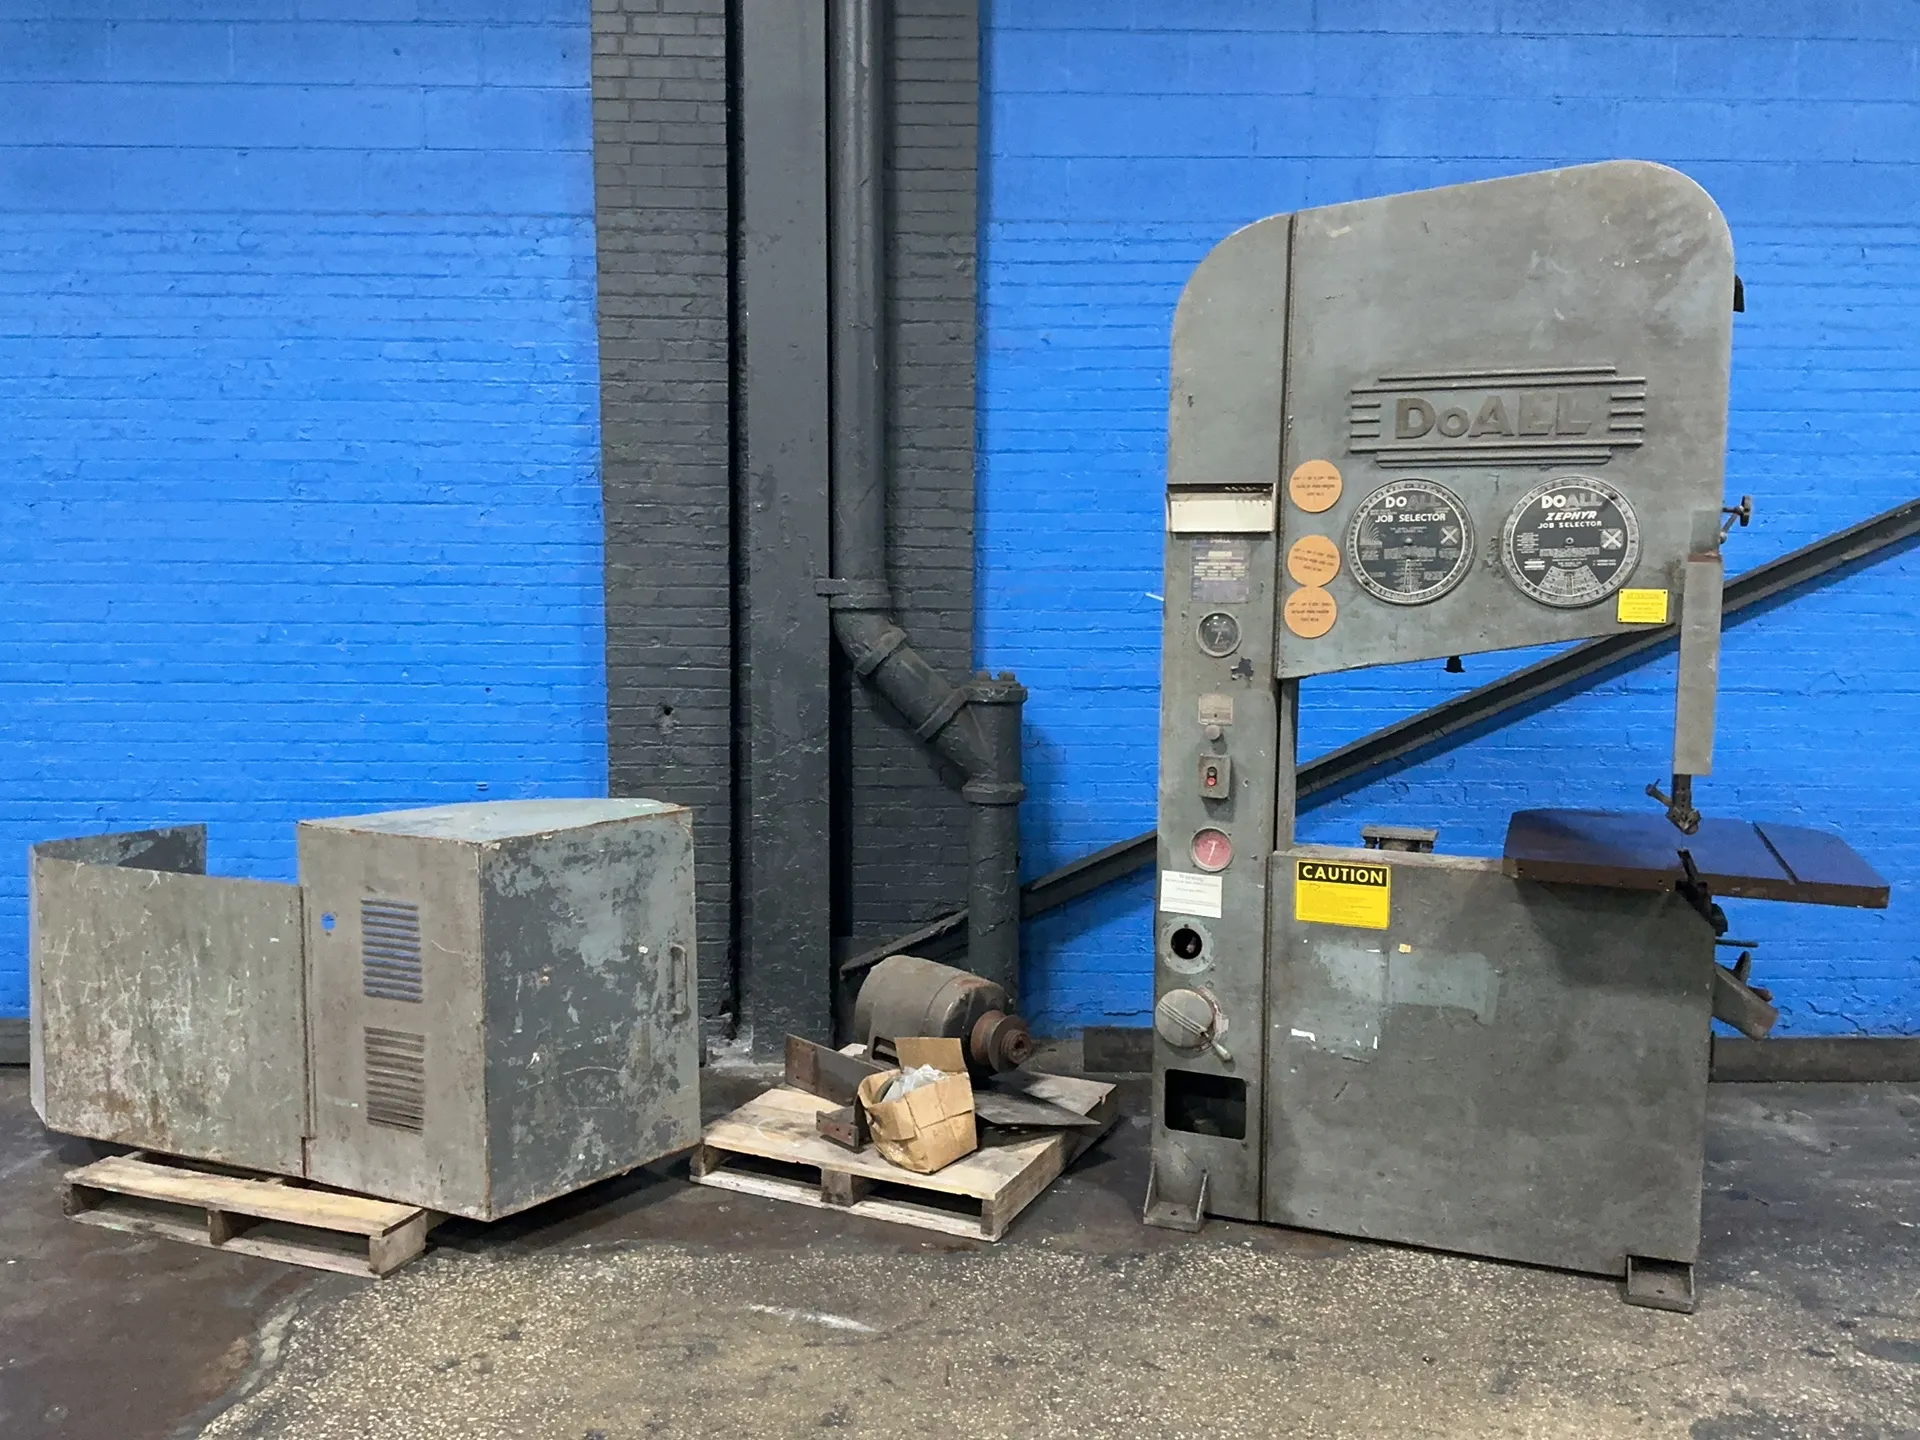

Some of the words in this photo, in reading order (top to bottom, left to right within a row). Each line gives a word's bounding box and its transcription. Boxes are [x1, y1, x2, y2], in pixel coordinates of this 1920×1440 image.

[1375, 515, 1393, 523] JOB
[1399, 513, 1446, 522] SELECTOR
[1545, 510, 1597, 521] ZEPHYR
[1302, 865, 1383, 884] CAUTION
